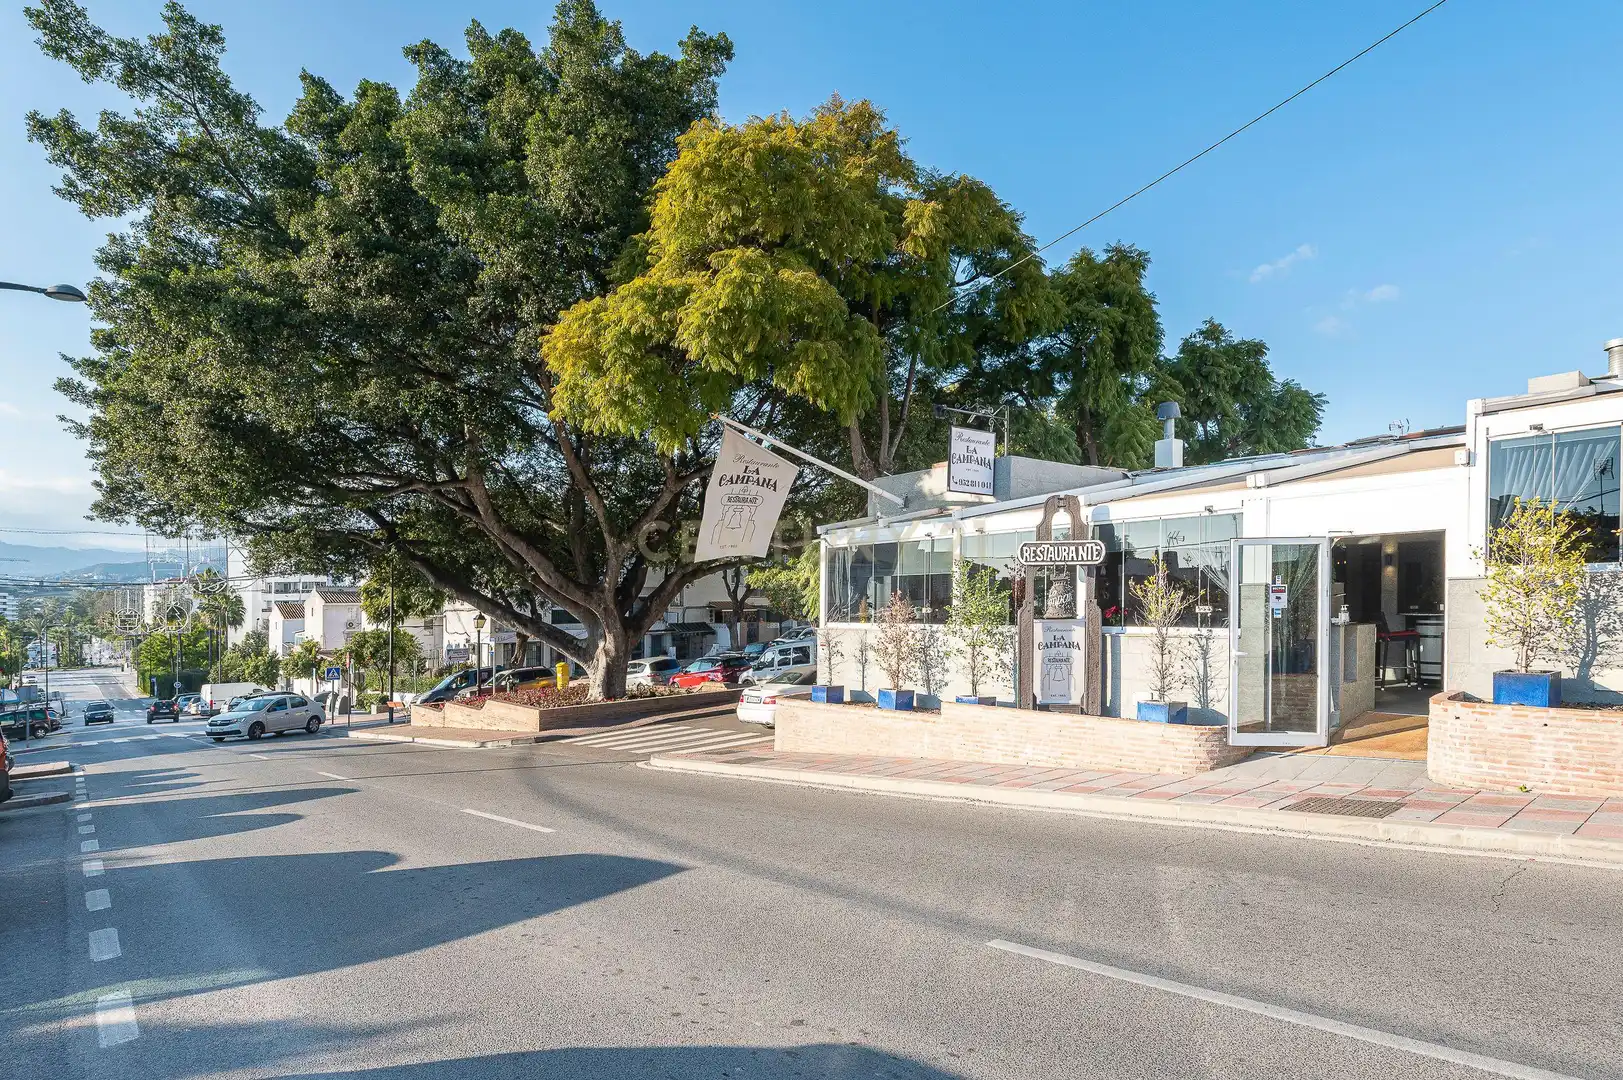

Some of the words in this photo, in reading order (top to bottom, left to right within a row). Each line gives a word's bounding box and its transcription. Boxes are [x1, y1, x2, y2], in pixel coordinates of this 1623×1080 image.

[966, 445, 978, 455] LA
[733, 453, 780, 469] Restaurante
[952, 453, 992, 470] CAMPANA
[743, 465, 760, 475] LA
[719, 474, 778, 492] CAMPANA
[1022, 543, 1101, 562] RESTAURANTE
[1038, 641, 1081, 651] CAMPANA
